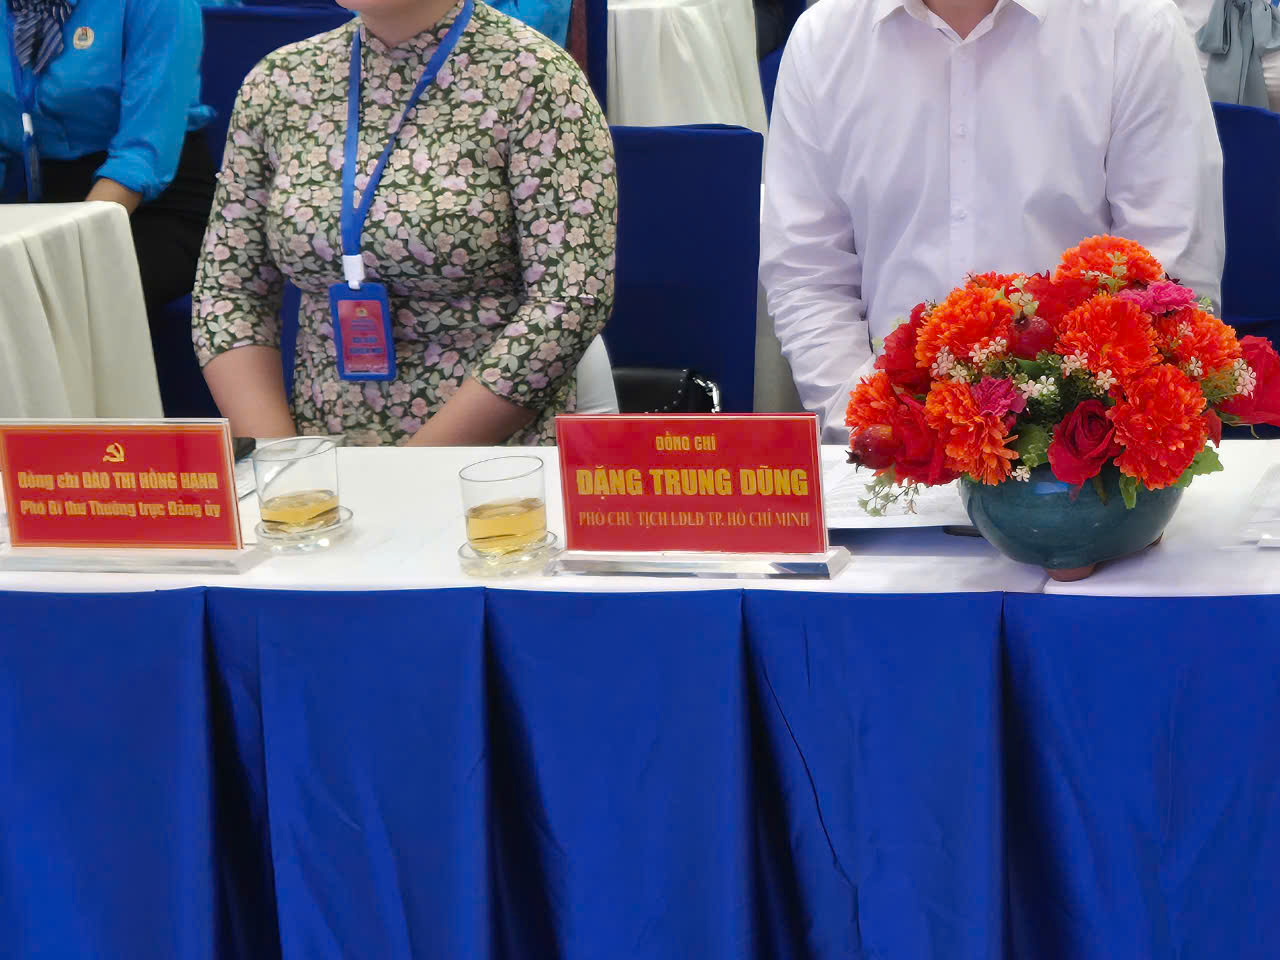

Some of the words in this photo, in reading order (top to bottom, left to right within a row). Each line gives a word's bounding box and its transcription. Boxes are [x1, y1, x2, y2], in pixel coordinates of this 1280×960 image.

[575, 465, 643, 500] ĐẶNG
[648, 468, 733, 496] TRUNG
[739, 465, 809, 497] DŨNG
